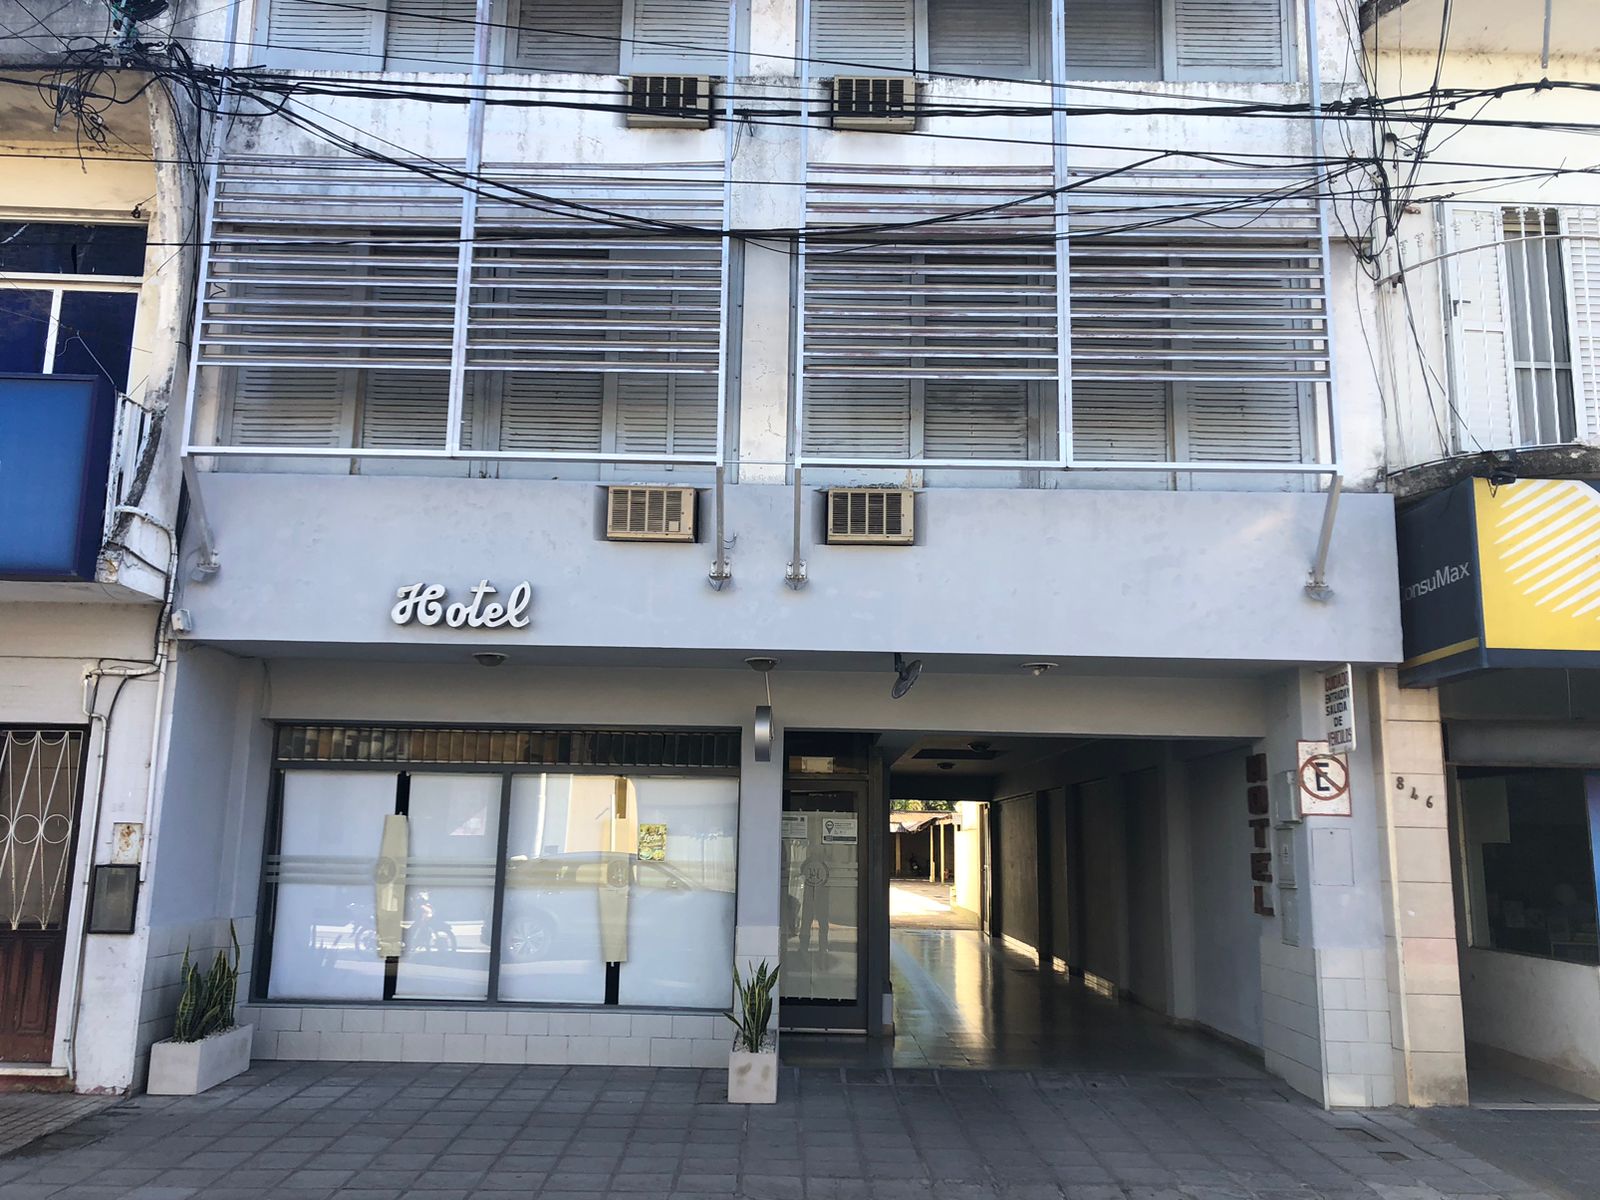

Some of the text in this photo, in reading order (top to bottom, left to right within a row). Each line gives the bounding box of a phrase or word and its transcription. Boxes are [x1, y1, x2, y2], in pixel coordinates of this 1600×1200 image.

[1401, 561, 1470, 601] onsuMax
[391, 579, 532, 628] Hotel
[1325, 701, 1347, 716] SALIDA
[1333, 716, 1343, 727] DE
[1315, 762, 1331, 791] E
[1396, 776, 1434, 809] 846
[1246, 752, 1276, 917] HOTEL
